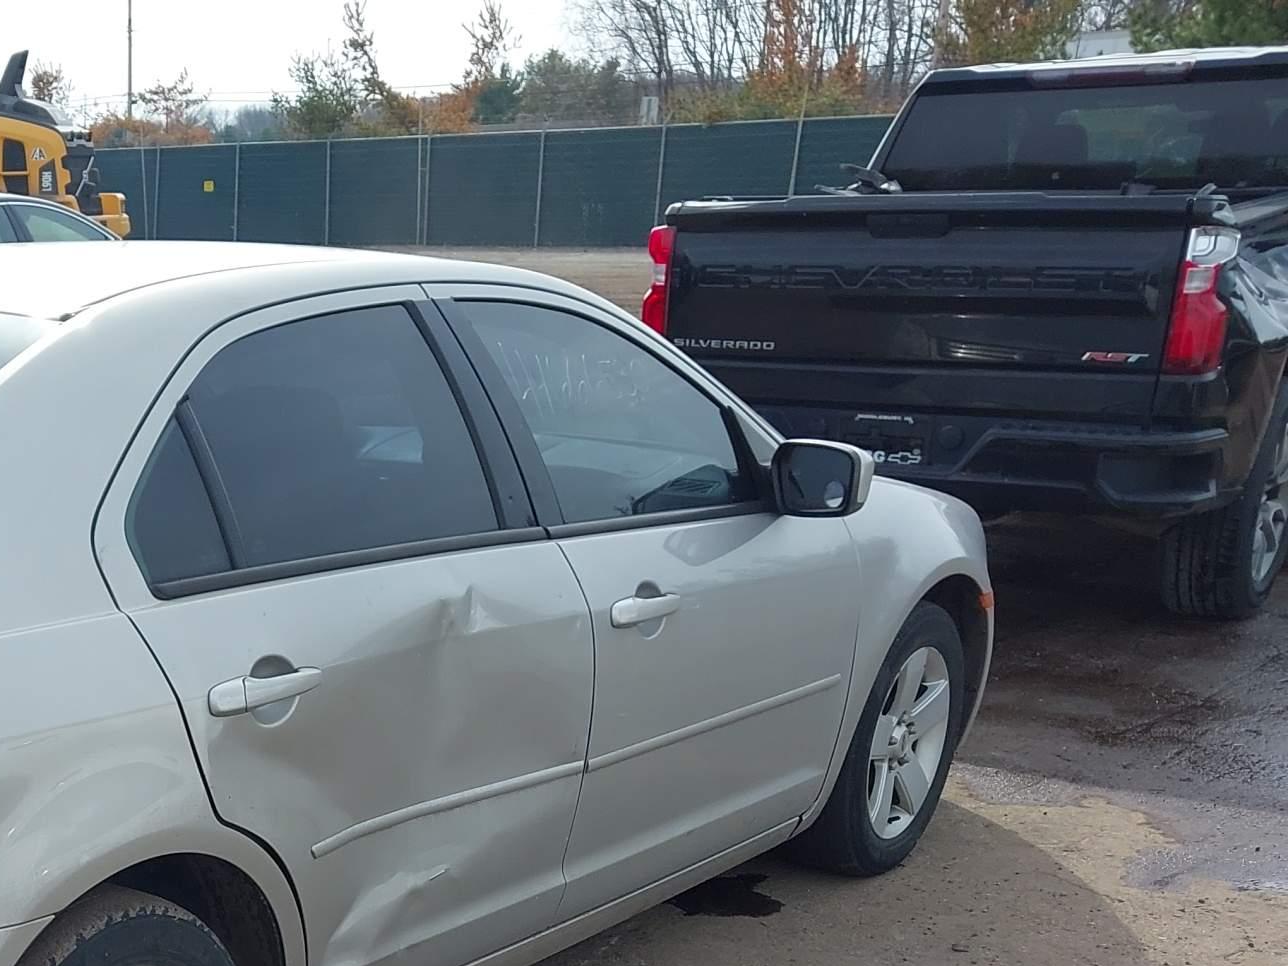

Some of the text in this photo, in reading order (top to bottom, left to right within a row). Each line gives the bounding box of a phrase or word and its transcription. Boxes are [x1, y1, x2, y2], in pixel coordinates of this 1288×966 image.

[41, 171, 52, 192] L90H
[673, 338, 776, 350] SILVERADO
[1081, 351, 1150, 362] RST
